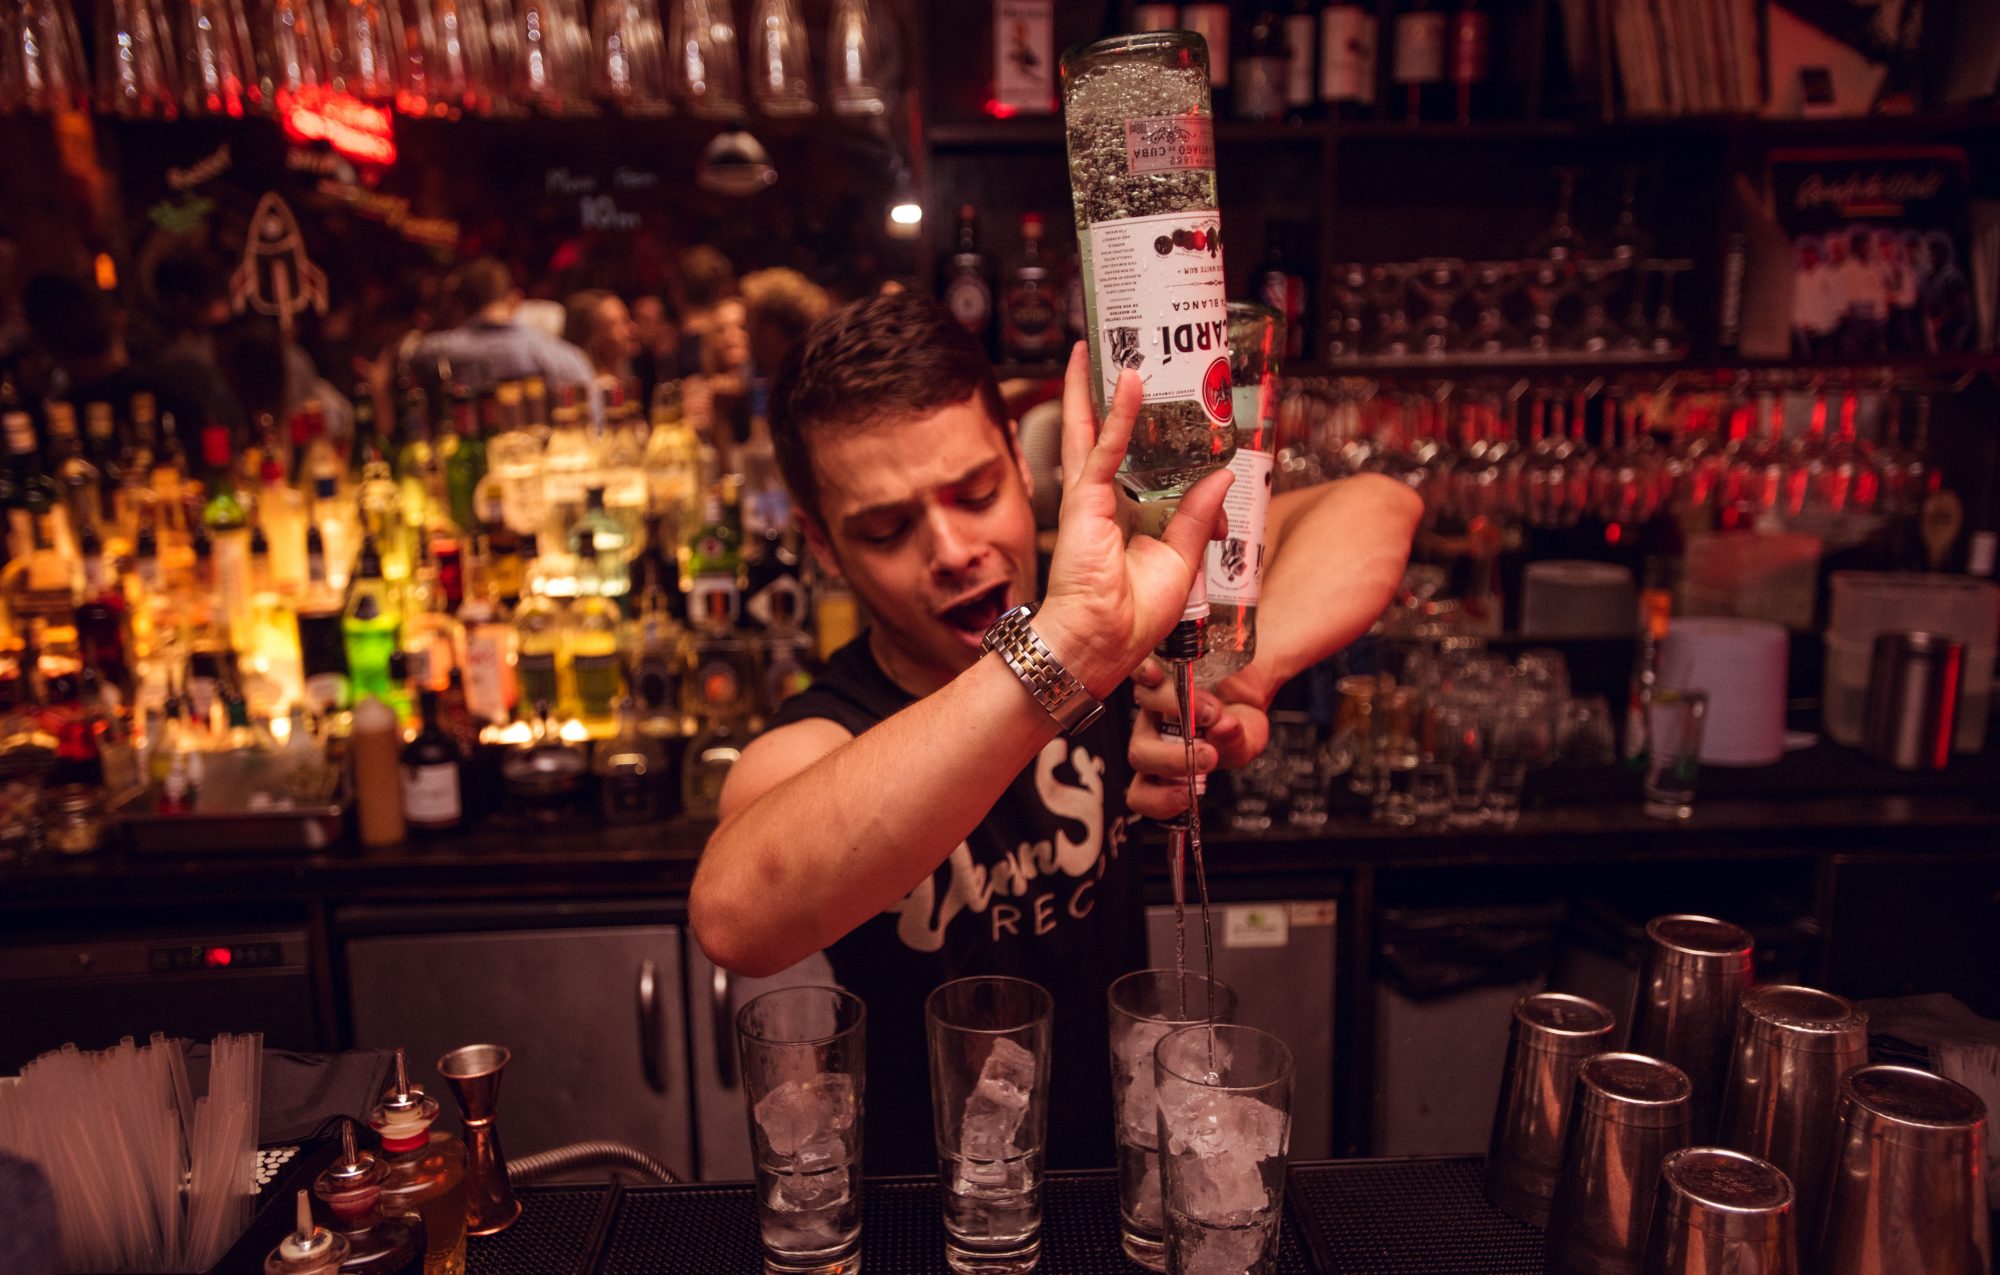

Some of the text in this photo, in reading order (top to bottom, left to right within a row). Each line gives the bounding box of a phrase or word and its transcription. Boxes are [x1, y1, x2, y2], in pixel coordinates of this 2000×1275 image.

[1133, 147, 1166, 158] CUBA
[1169, 155, 1193, 165] 1862
[1172, 298, 1219, 311] BLANCA
